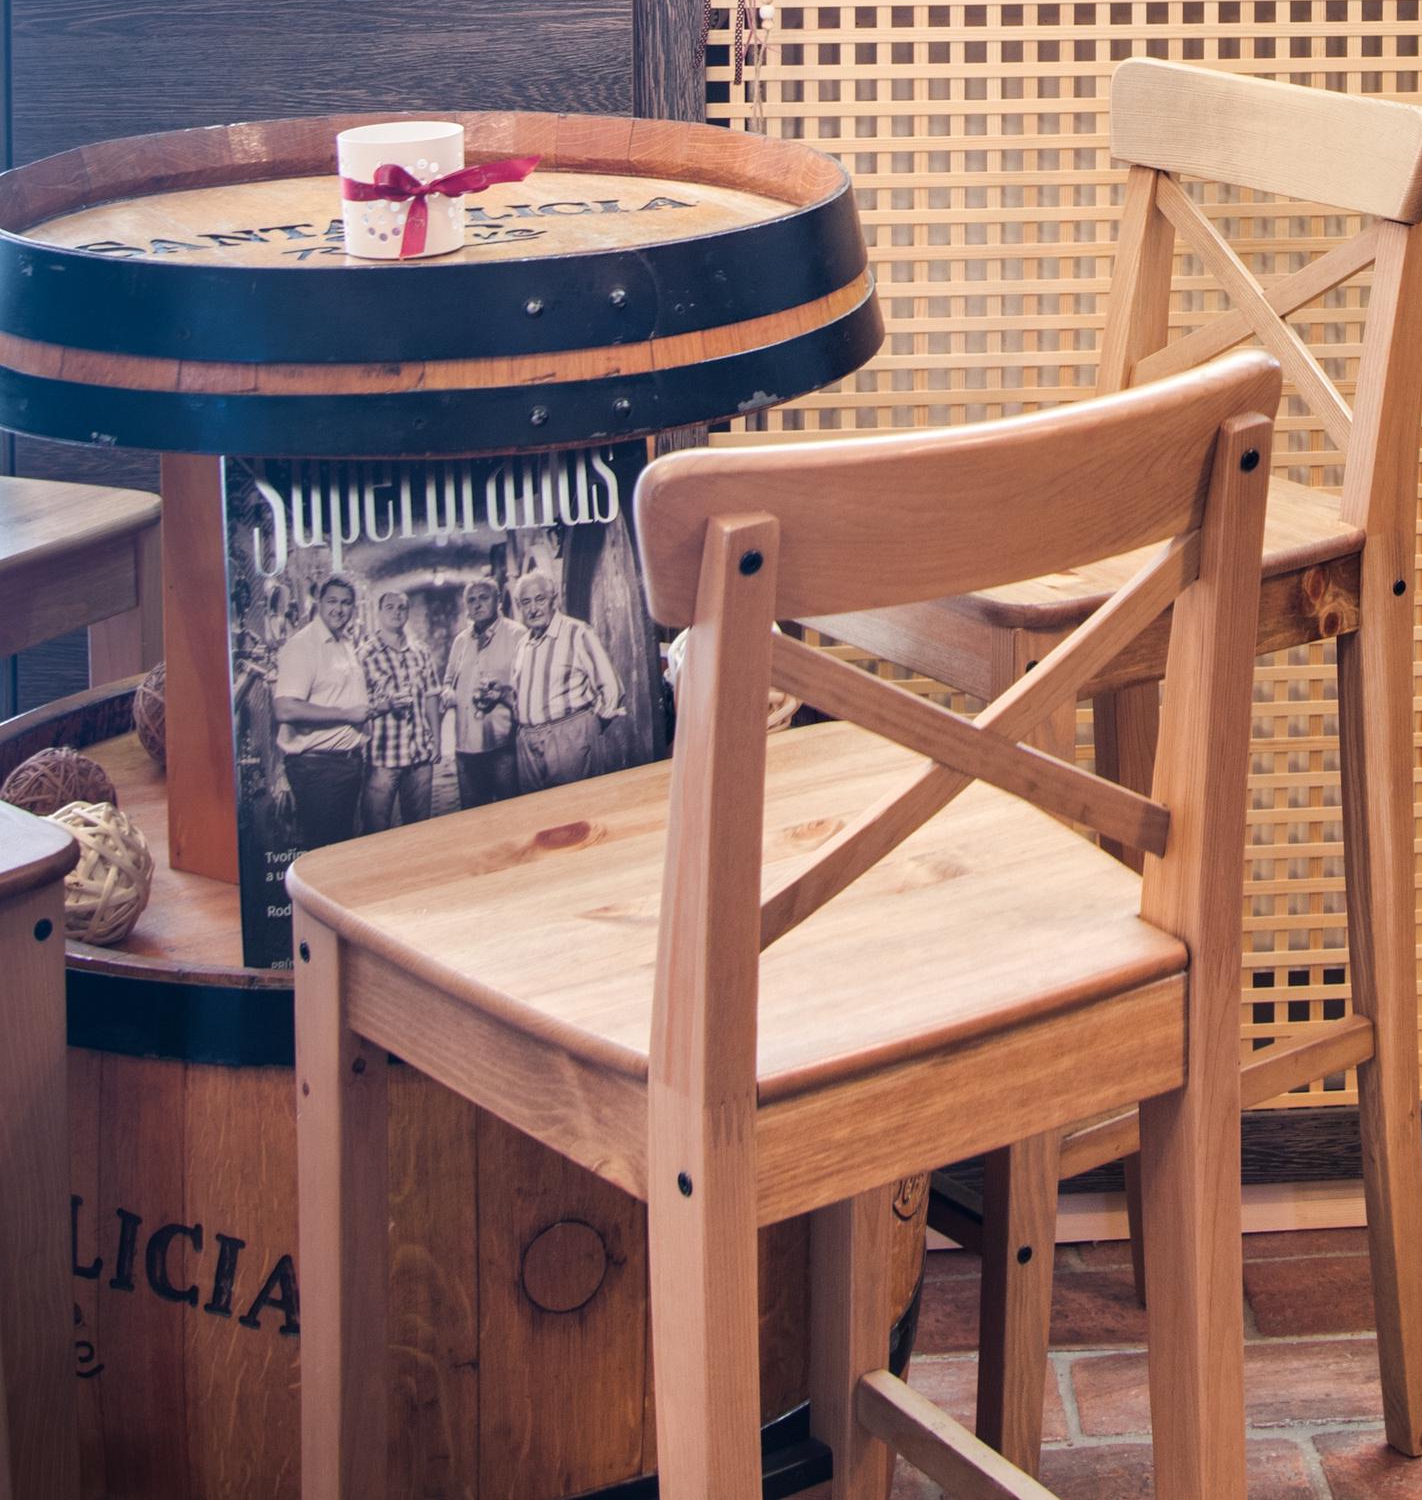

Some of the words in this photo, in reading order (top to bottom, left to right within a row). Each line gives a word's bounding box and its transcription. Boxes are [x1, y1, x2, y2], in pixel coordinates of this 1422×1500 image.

[467, 194, 698, 222] LICIA
[253, 449, 620, 577] Superbrands
[265, 848, 304, 864] Tvoří
[265, 871, 274, 882] a
[267, 904, 293, 918] Rod
[70, 1194, 300, 1336] LICIA
